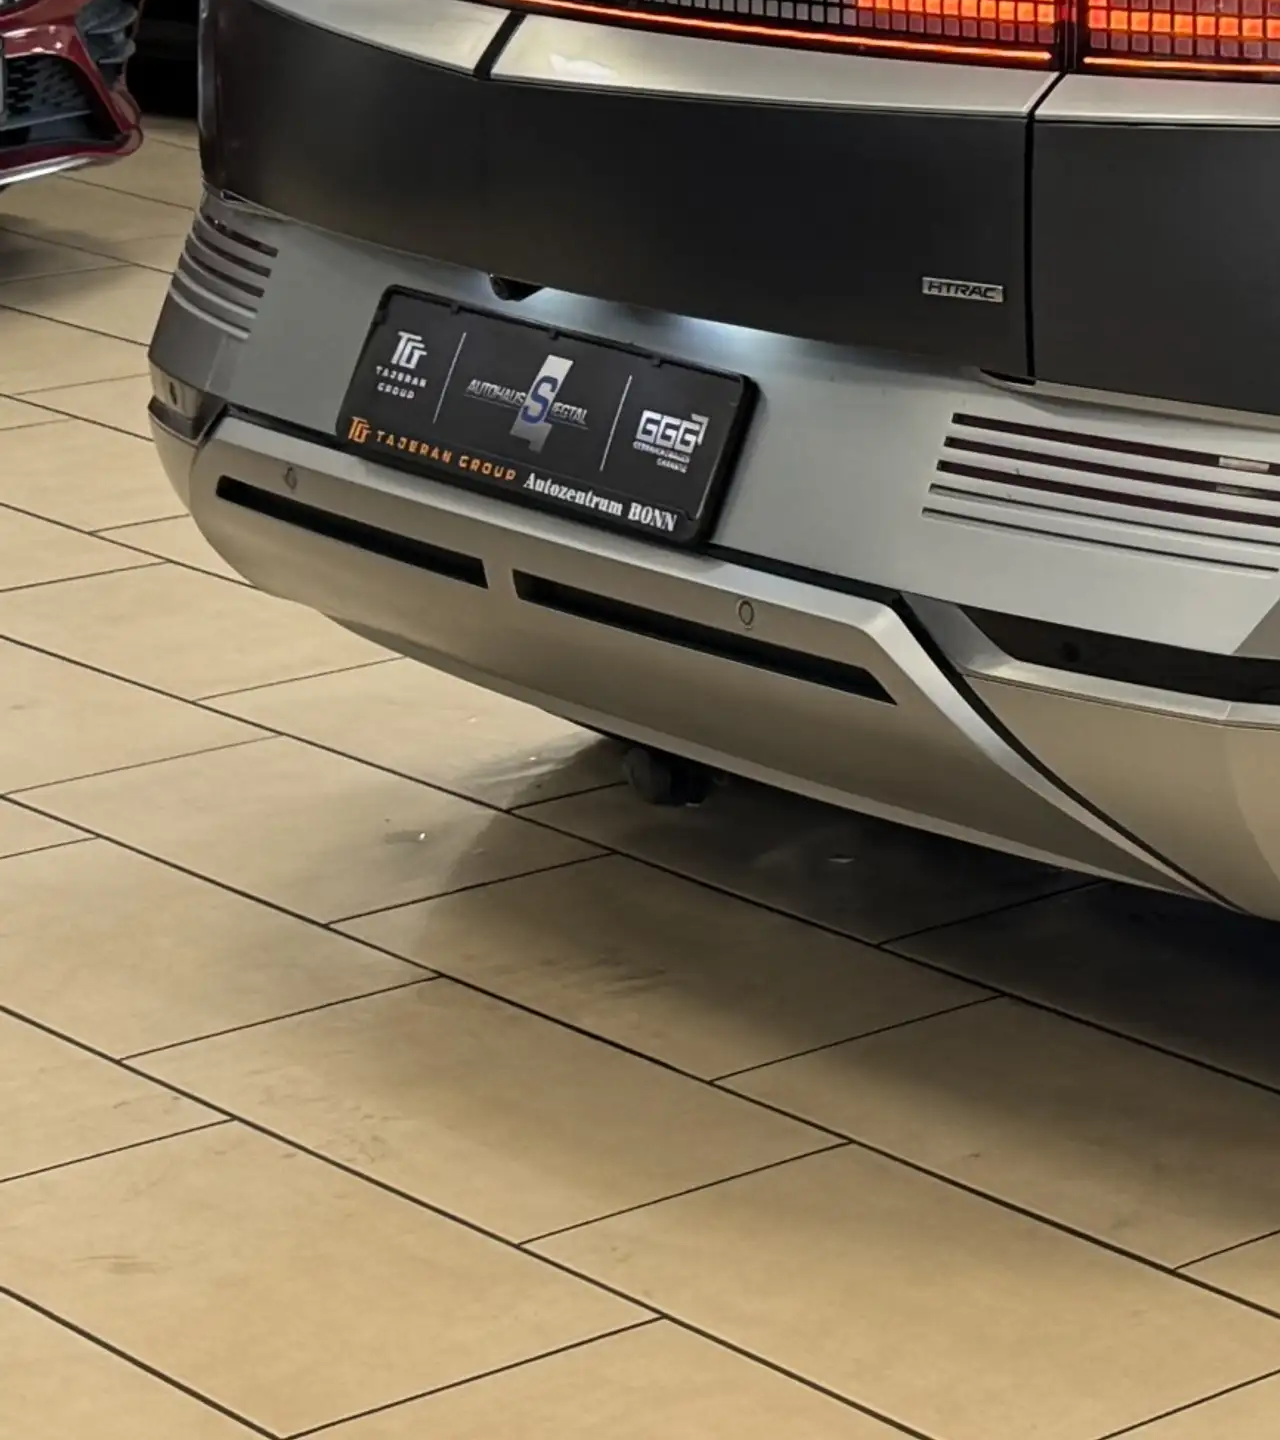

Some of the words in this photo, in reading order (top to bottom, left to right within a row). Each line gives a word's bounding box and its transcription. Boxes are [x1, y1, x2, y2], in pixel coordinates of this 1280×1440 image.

[927, 279, 997, 300] HTRAC
[466, 378, 527, 407] AUTOHAUS
[636, 409, 702, 454] GGG
[376, 430, 453, 464] TAJERAN
[458, 455, 517, 481] GROUP
[524, 472, 623, 517] Autozentrum
[627, 502, 677, 532] BONN
